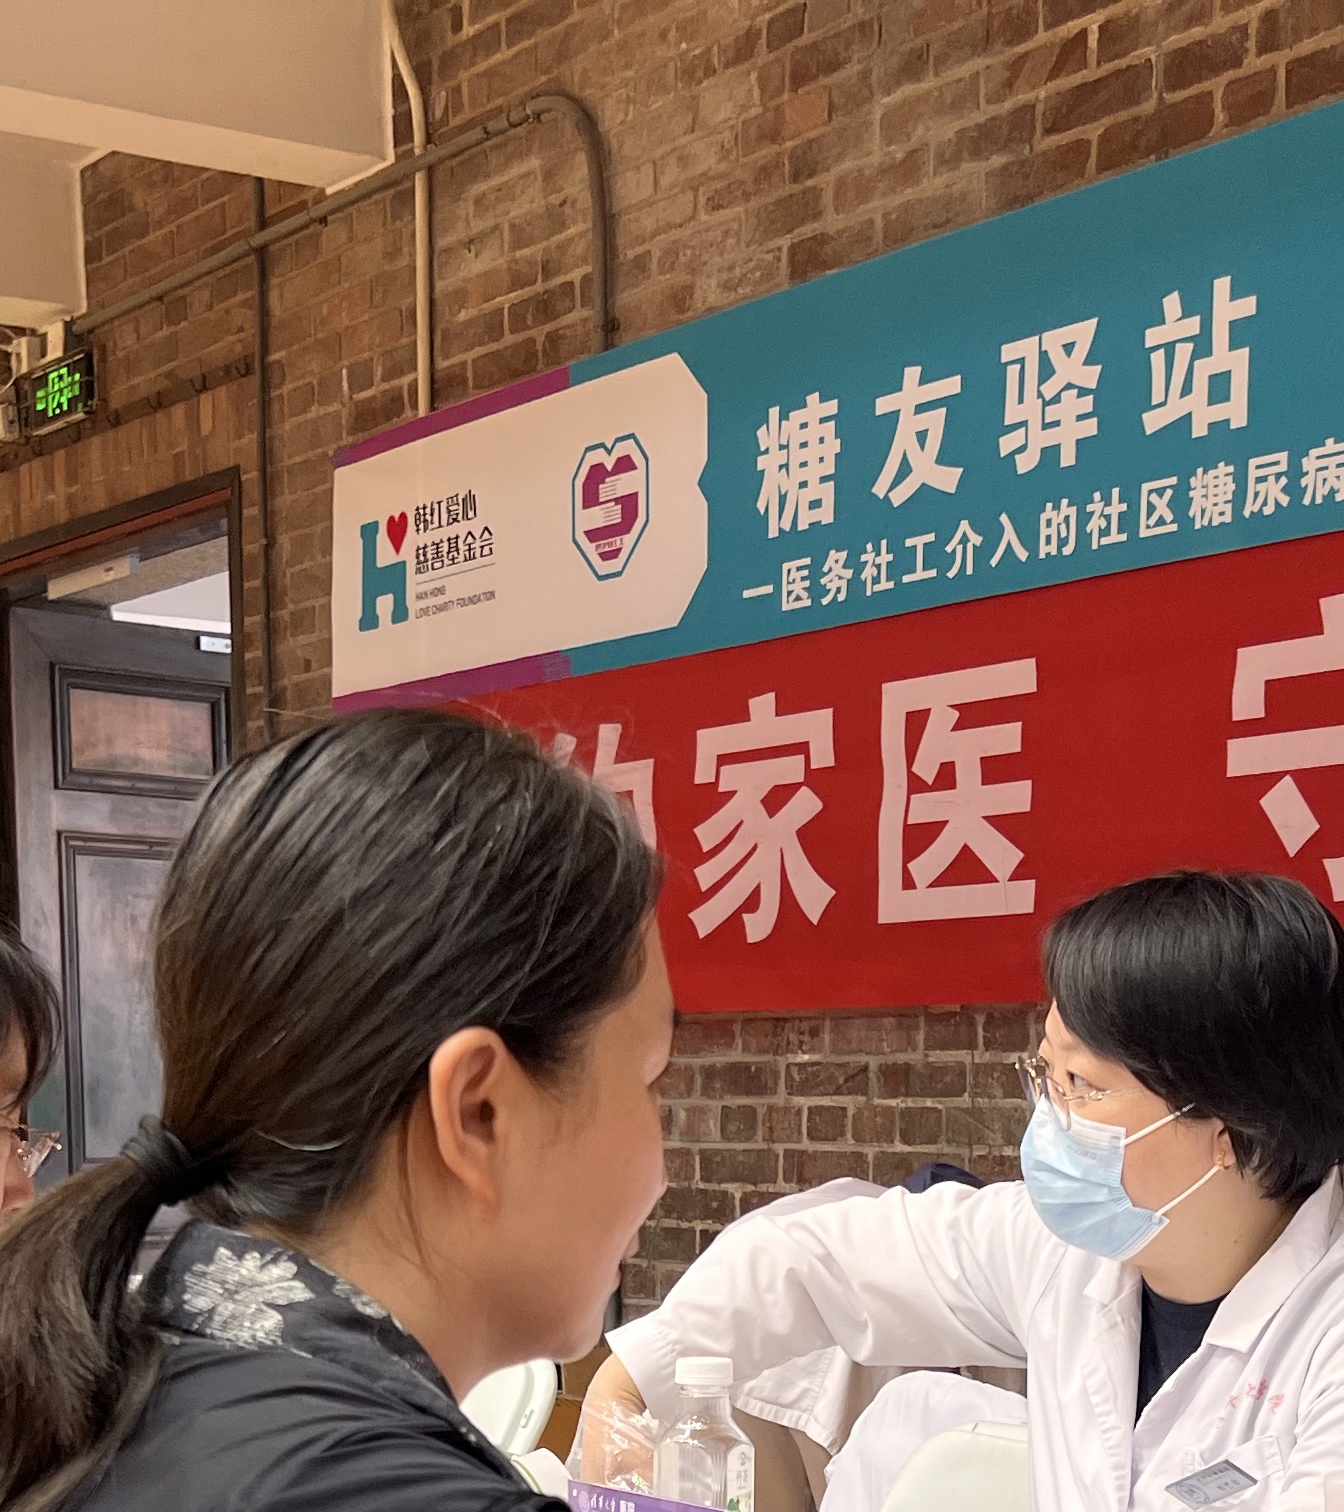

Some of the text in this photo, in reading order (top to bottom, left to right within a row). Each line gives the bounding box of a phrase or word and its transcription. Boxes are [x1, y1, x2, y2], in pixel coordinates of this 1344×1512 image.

[413, 488, 478, 535] 韩红爱心
[413, 525, 495, 576] 慈善基金会
